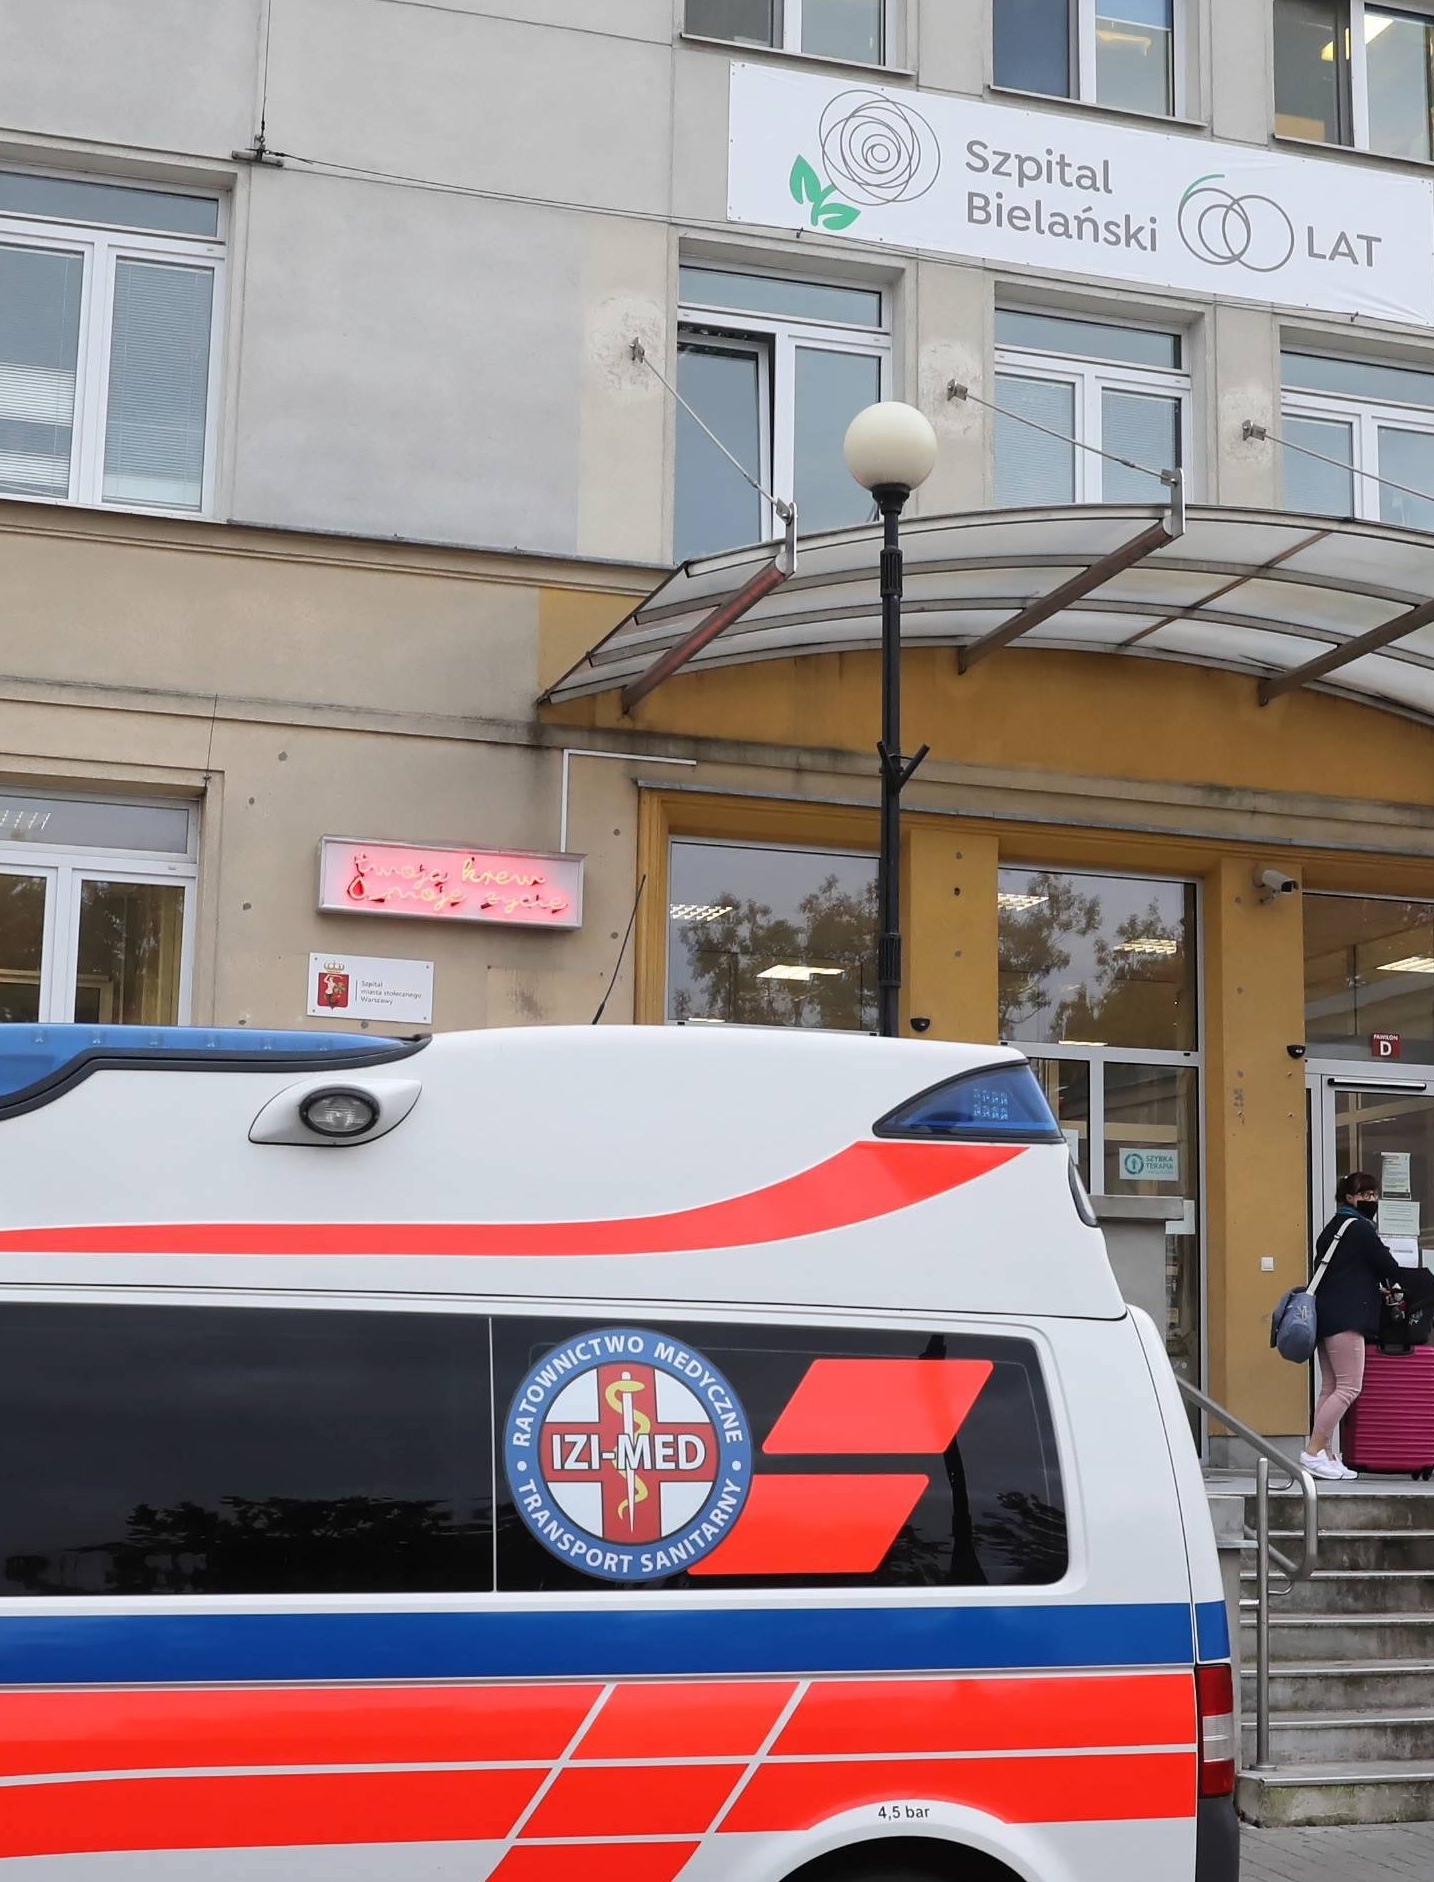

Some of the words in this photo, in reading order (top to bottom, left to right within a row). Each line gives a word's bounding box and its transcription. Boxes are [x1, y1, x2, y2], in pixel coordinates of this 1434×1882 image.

[966, 140, 1113, 195] Szpital
[967, 191, 1159, 252] Bielański
[1306, 225, 1383, 268] LAT
[462, 857, 546, 886] krew
[361, 980, 383, 988] Szpital
[1380, 1040, 1392, 1056] D
[1145, 1154, 1174, 1162] SZYBKA
[513, 1335, 644, 1447] RATOWNICTWO
[653, 1341, 744, 1444] MEDYCZNE
[551, 1433, 706, 1471] IZI-MED
[518, 1478, 633, 1574] TRANSPORT
[641, 1478, 742, 1574] SANITARNY
[878, 1805, 901, 1820] 4,5
[905, 1805, 930, 1818] bar
